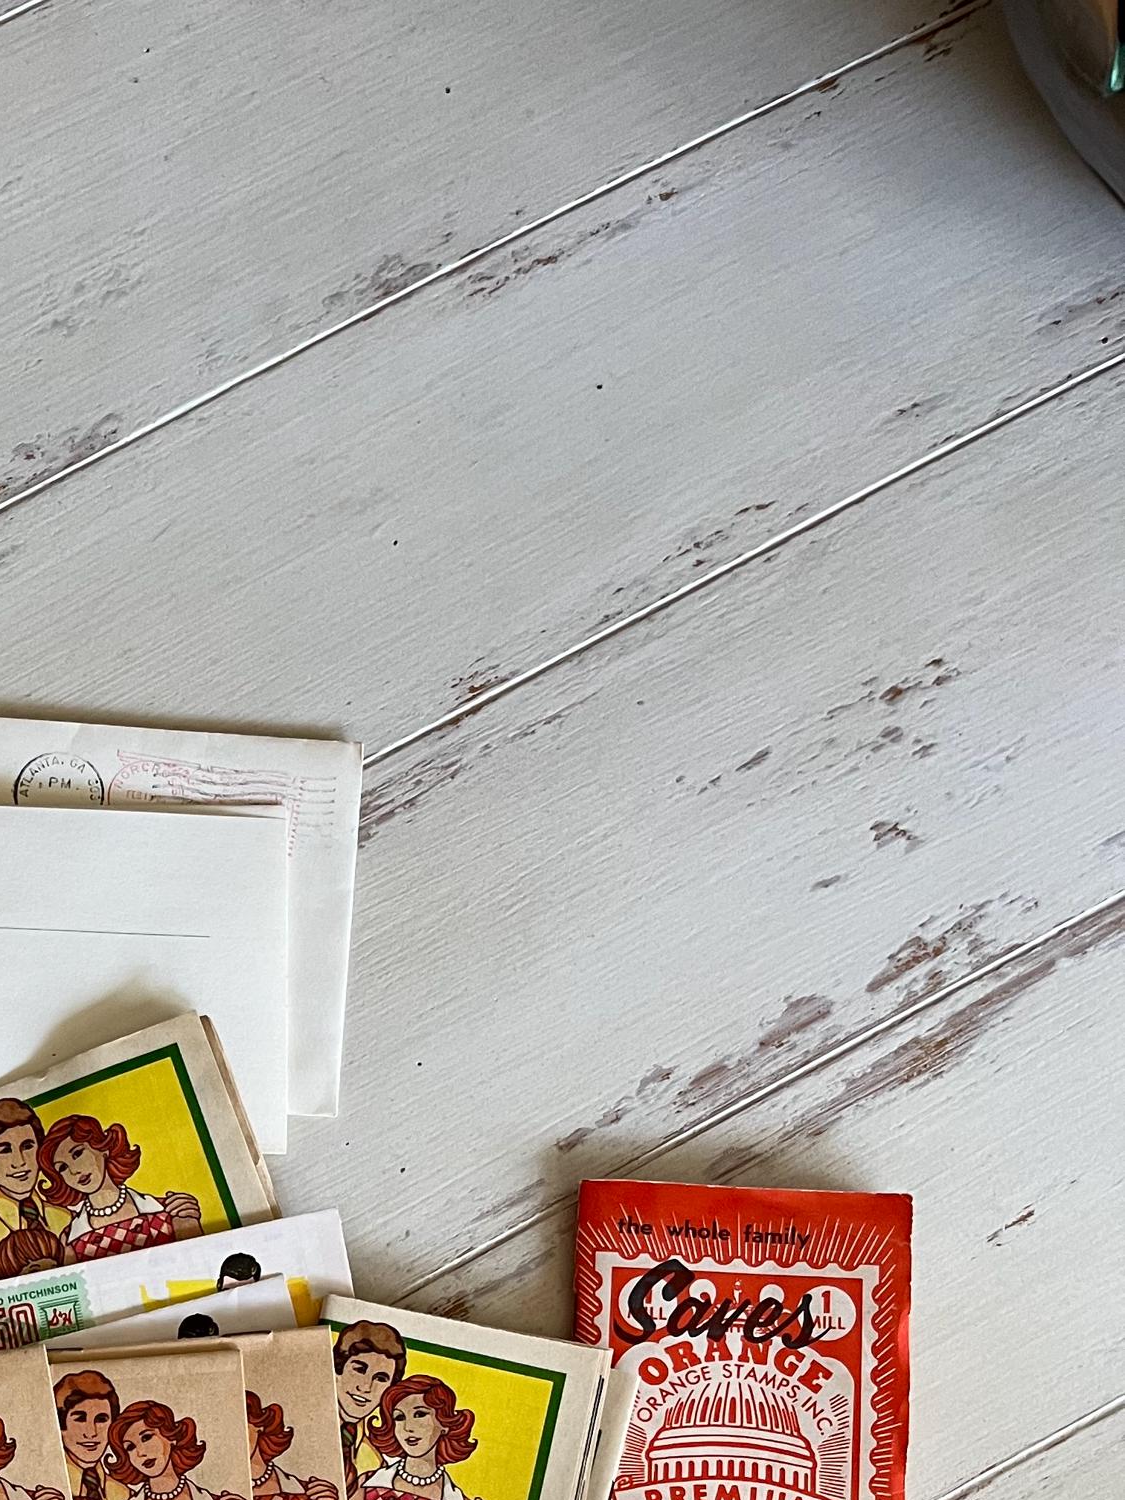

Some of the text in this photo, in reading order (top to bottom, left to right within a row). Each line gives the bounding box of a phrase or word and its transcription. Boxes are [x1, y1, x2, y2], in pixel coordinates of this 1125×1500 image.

[48, 776, 72, 790] PM
[617, 1217, 811, 1251] the whole family
[8, 1281, 77, 1305] HUTCHINSON
[613, 1259, 832, 1350] Saves
[638, 1336, 834, 1395] ORANGE
[636, 1363, 834, 1436] ORANGE STAMPS, INC.
